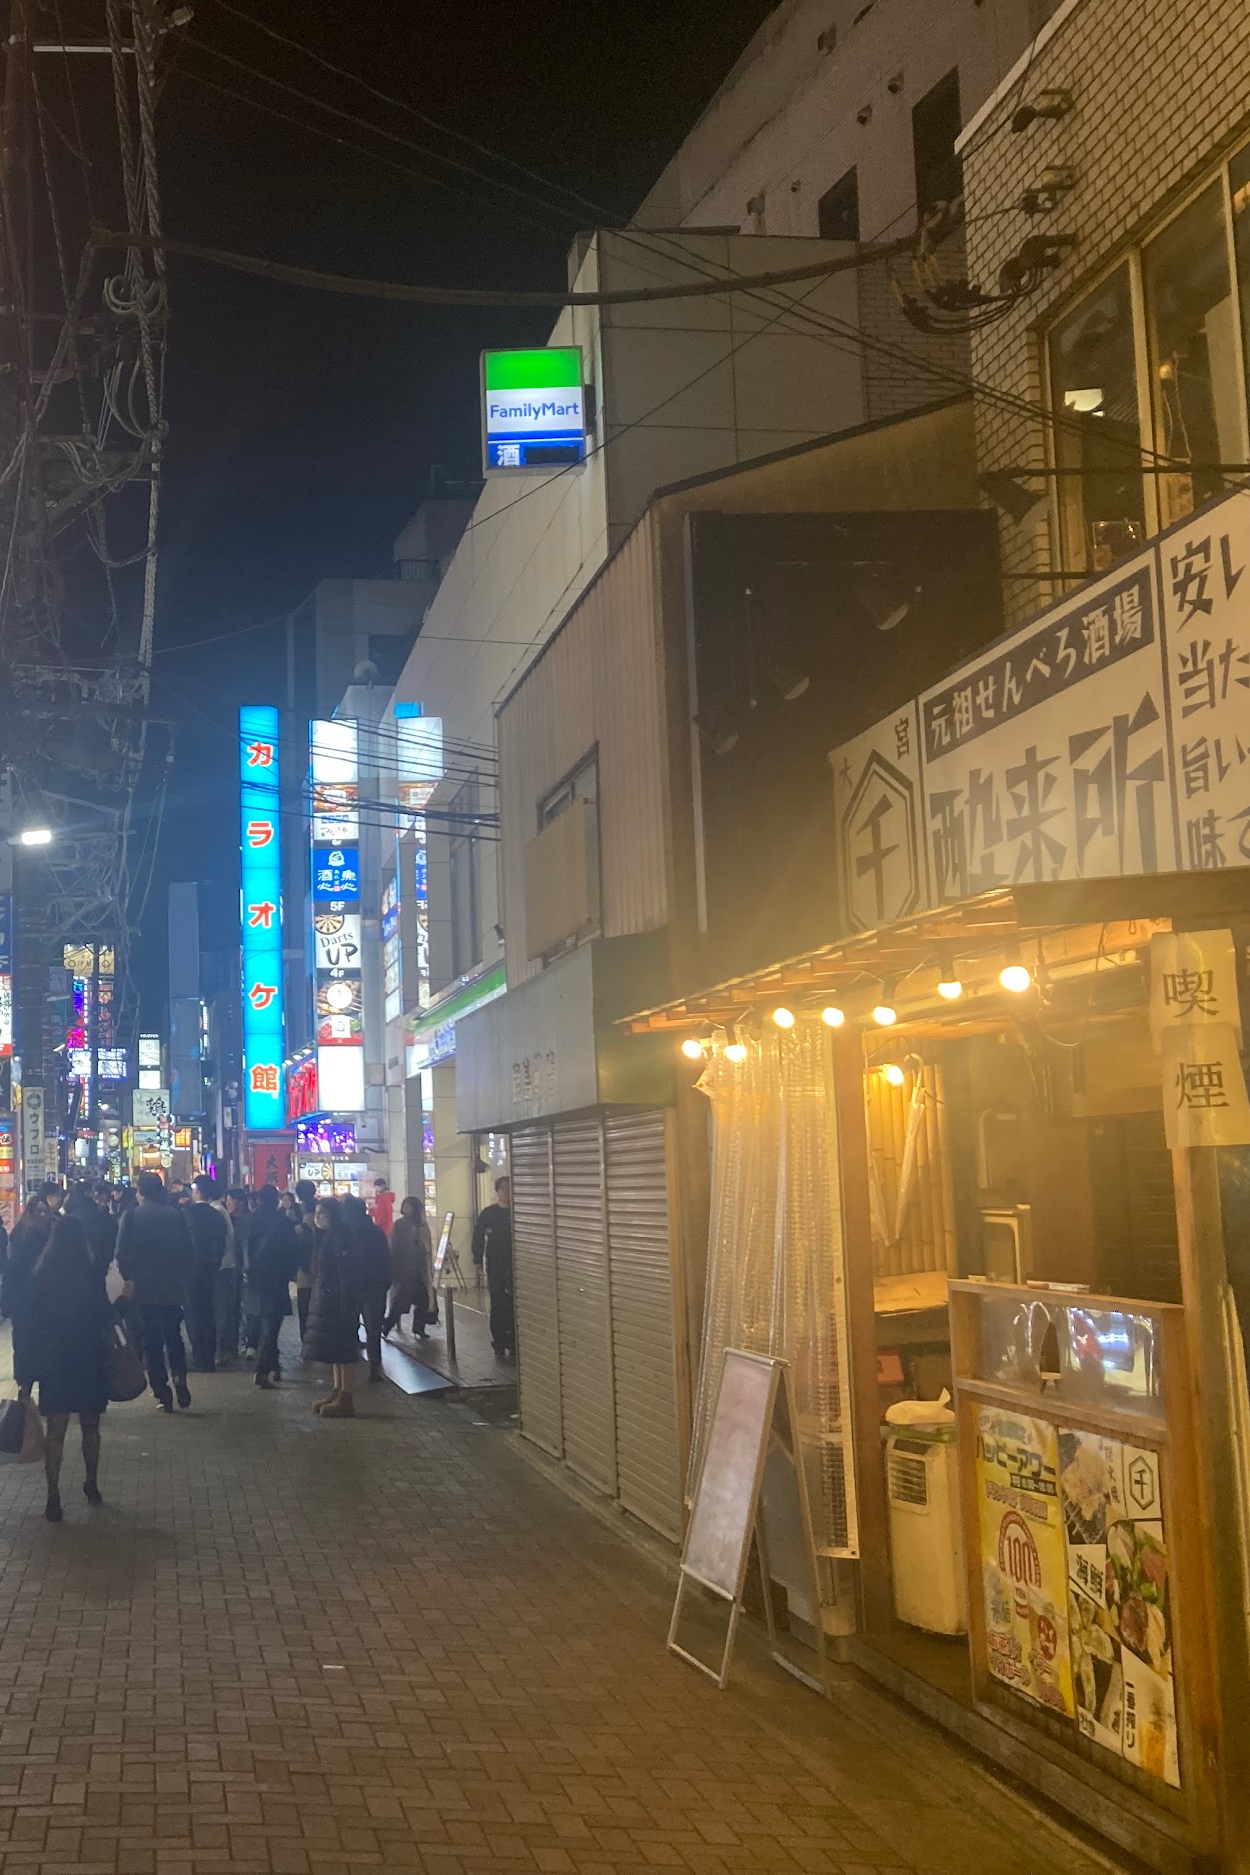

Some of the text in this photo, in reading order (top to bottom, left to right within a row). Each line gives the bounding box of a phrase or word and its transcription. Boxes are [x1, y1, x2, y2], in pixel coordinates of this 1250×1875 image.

[490, 402, 580, 420] FamilyMart
[497, 444, 521, 467] 酒
[929, 589, 1143, 750] 元祖せんべろ酒場
[854, 794, 901, 921] 千
[247, 741, 279, 1092] カラオケ館
[330, 901, 346, 911] 5F
[320, 932, 354, 948] Darts
[325, 943, 358, 966] UP
[330, 968, 345, 978] 4F
[1162, 968, 1230, 1110] 喫煙
[1133, 1468, 1149, 1500] 千
